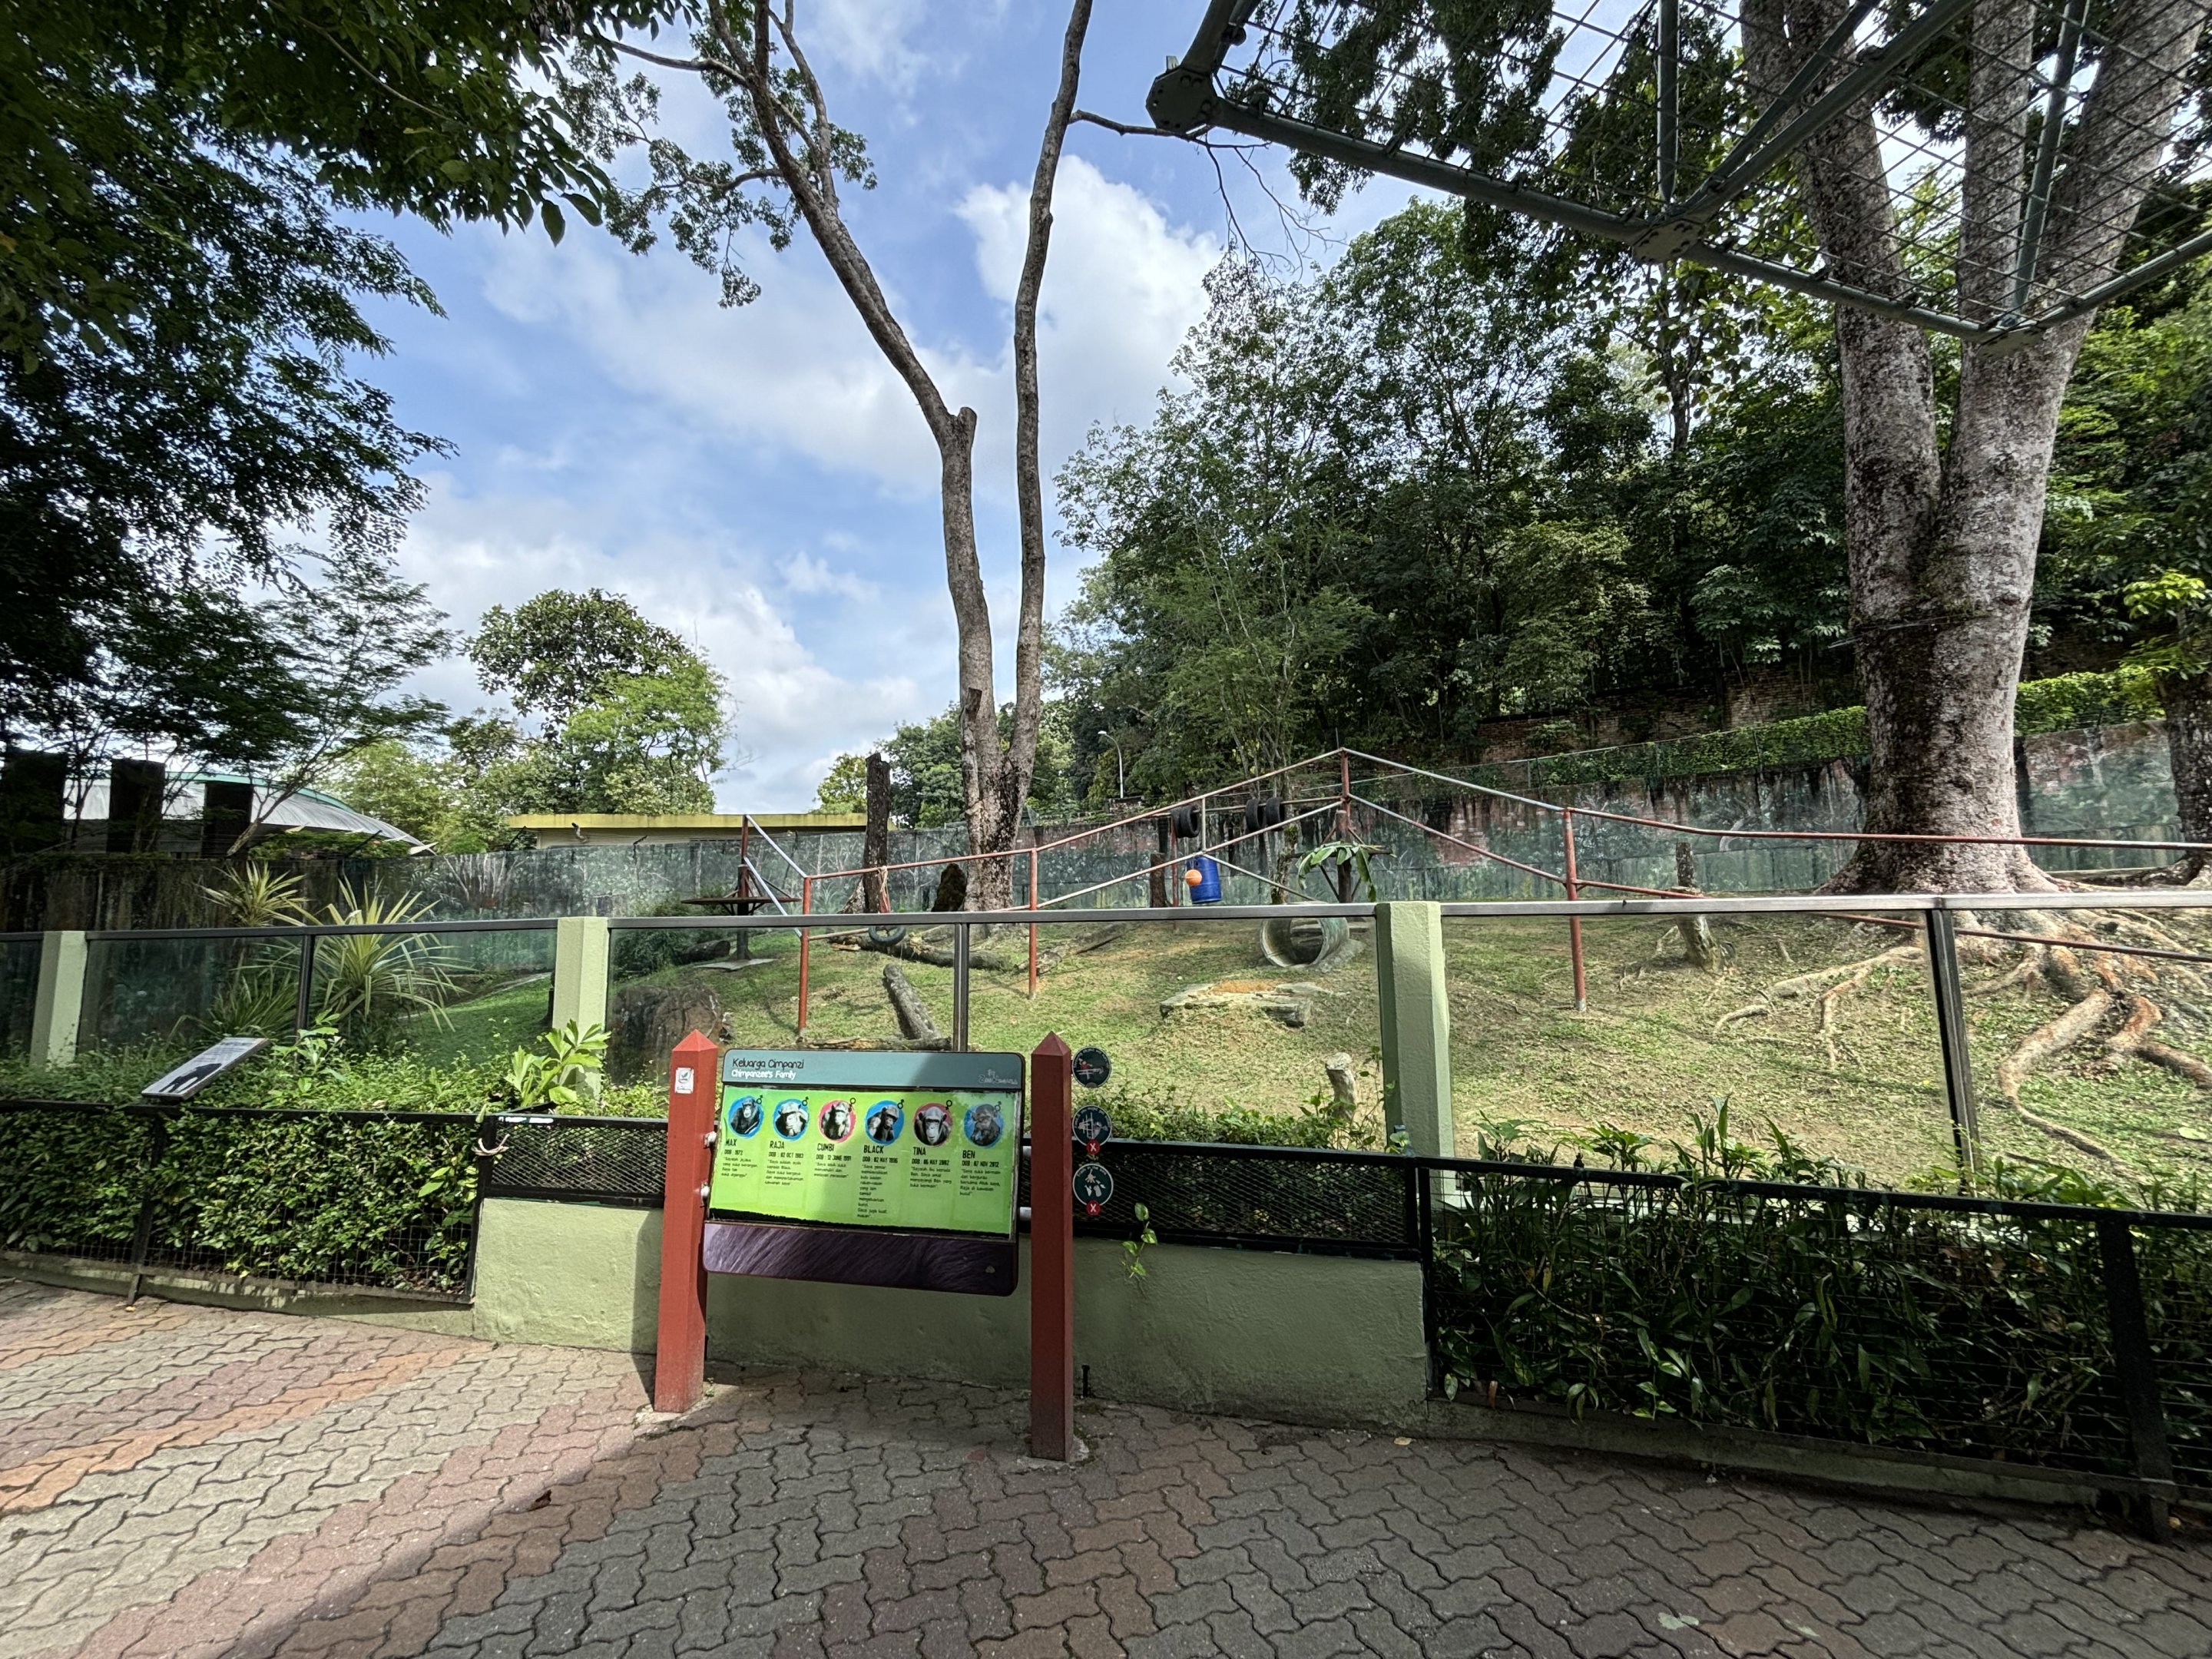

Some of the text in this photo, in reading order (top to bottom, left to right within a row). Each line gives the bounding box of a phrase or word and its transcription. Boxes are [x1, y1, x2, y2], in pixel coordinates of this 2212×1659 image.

[733, 1058, 804, 1070] Keluarga Cimpanzi
[731, 1069, 796, 1080] Chimpanzee's Family
[770, 1141, 784, 1149] RAJA
[817, 1143, 834, 1151] CUMBI
[863, 1144, 884, 1154] BLACK
[913, 1147, 926, 1155] TINA
[962, 1150, 975, 1158] BEN
